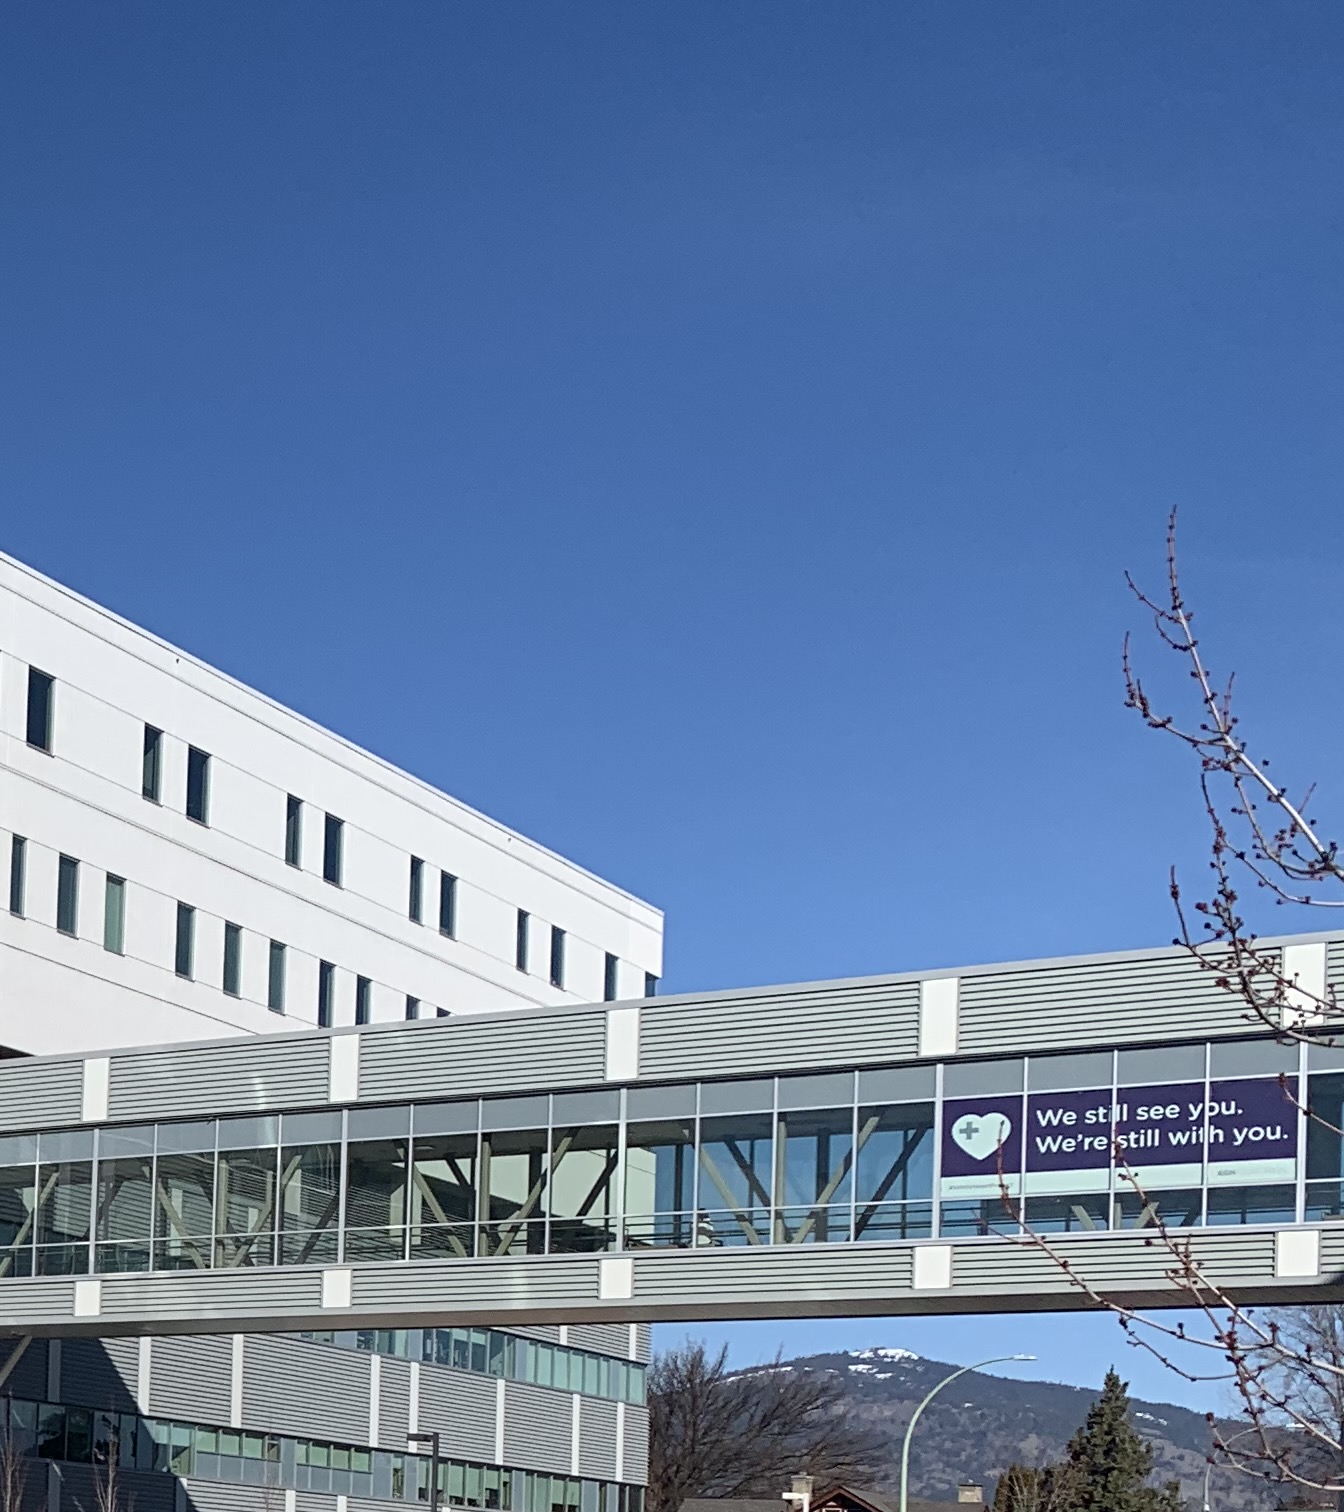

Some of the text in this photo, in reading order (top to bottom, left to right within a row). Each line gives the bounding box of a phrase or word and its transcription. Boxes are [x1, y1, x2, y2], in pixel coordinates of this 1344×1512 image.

[1036, 1099, 1243, 1127] We still see you.
[1036, 1124, 1289, 1153] We're still with you.
